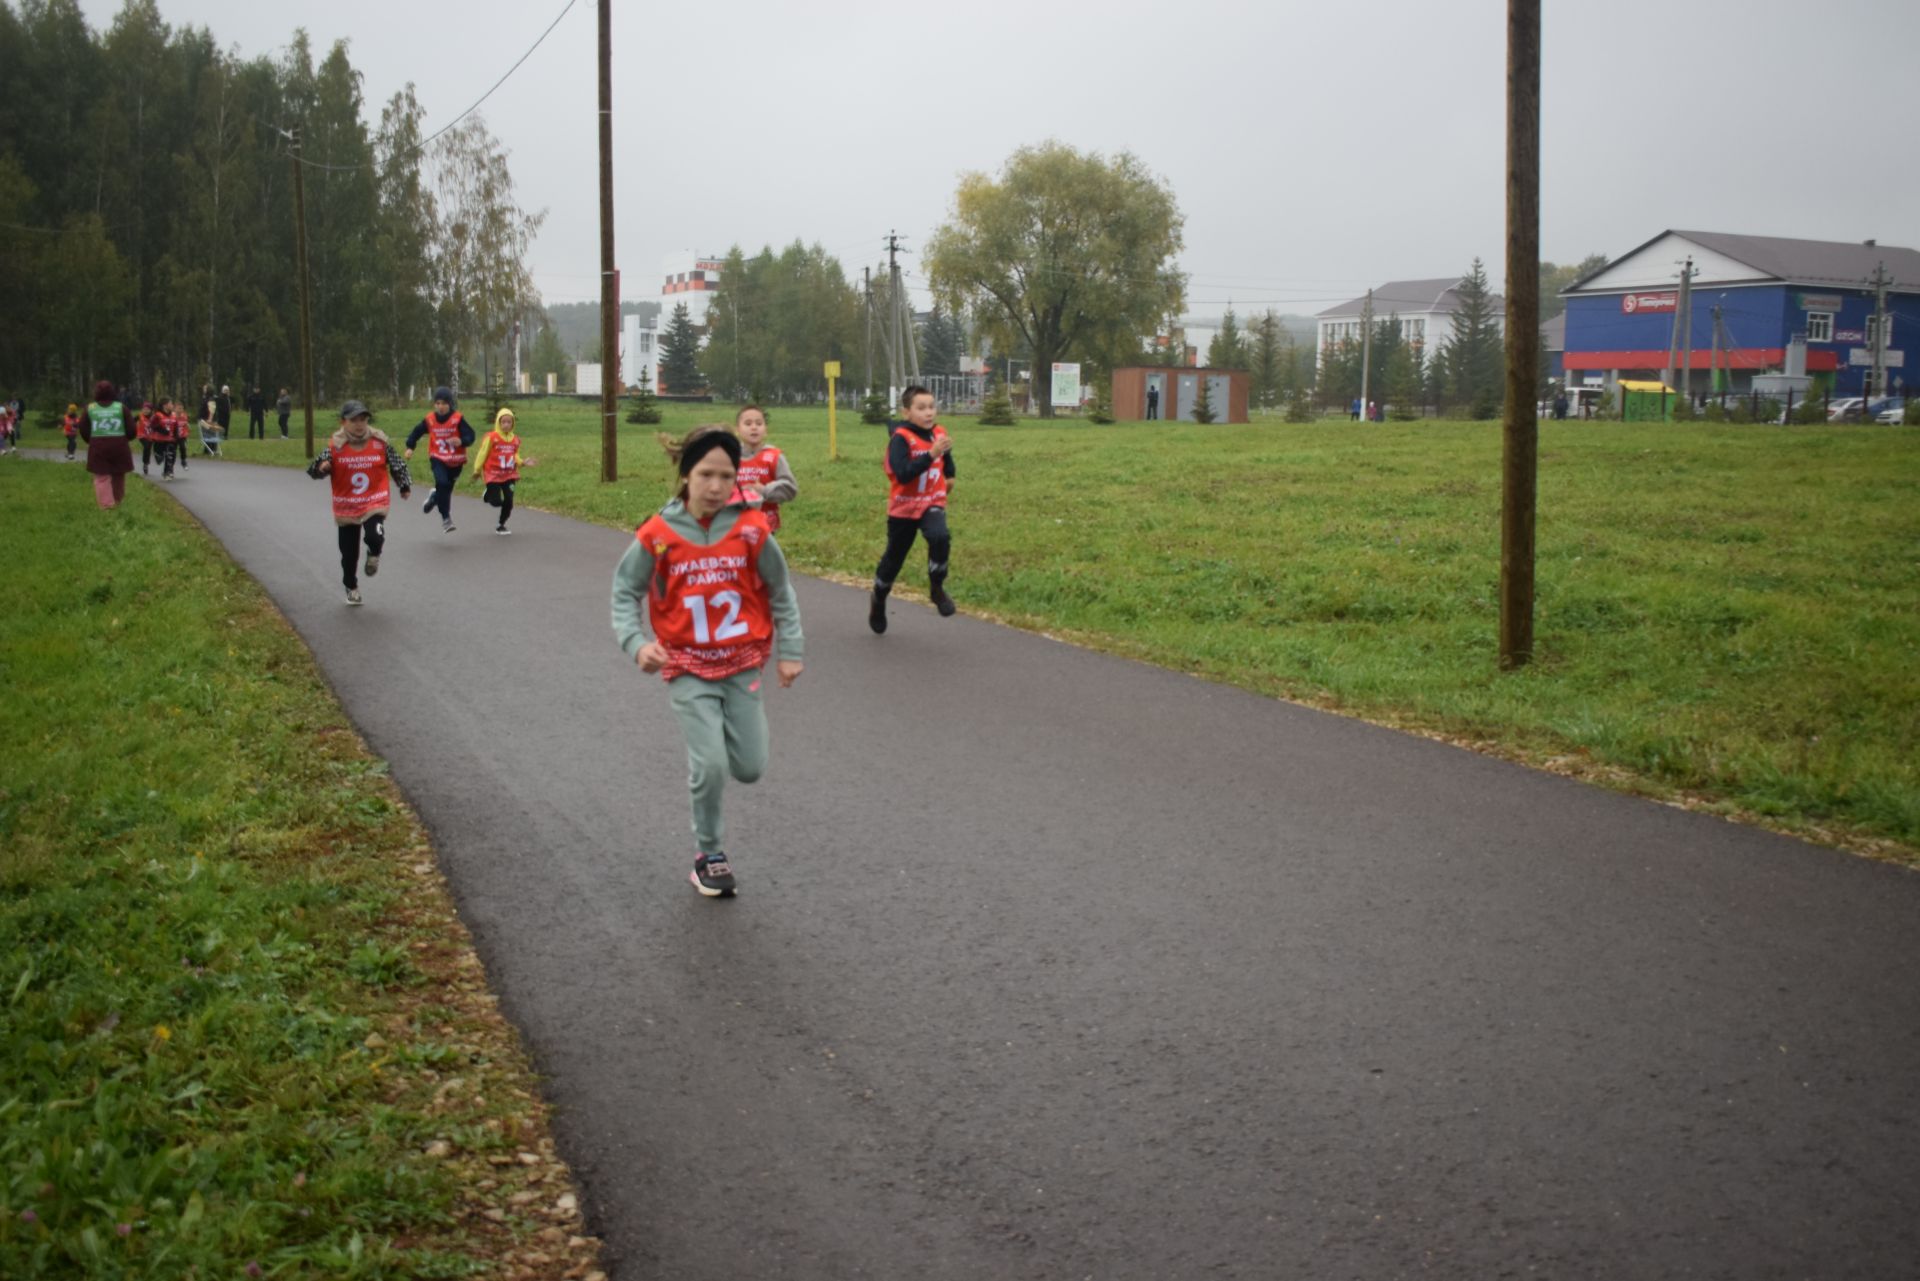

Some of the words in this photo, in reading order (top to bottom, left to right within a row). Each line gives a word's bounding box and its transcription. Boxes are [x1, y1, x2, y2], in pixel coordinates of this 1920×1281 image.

[351, 472, 369, 494] 9
[687, 567, 738, 586] РАЙОН
[683, 590, 749, 643] 12
